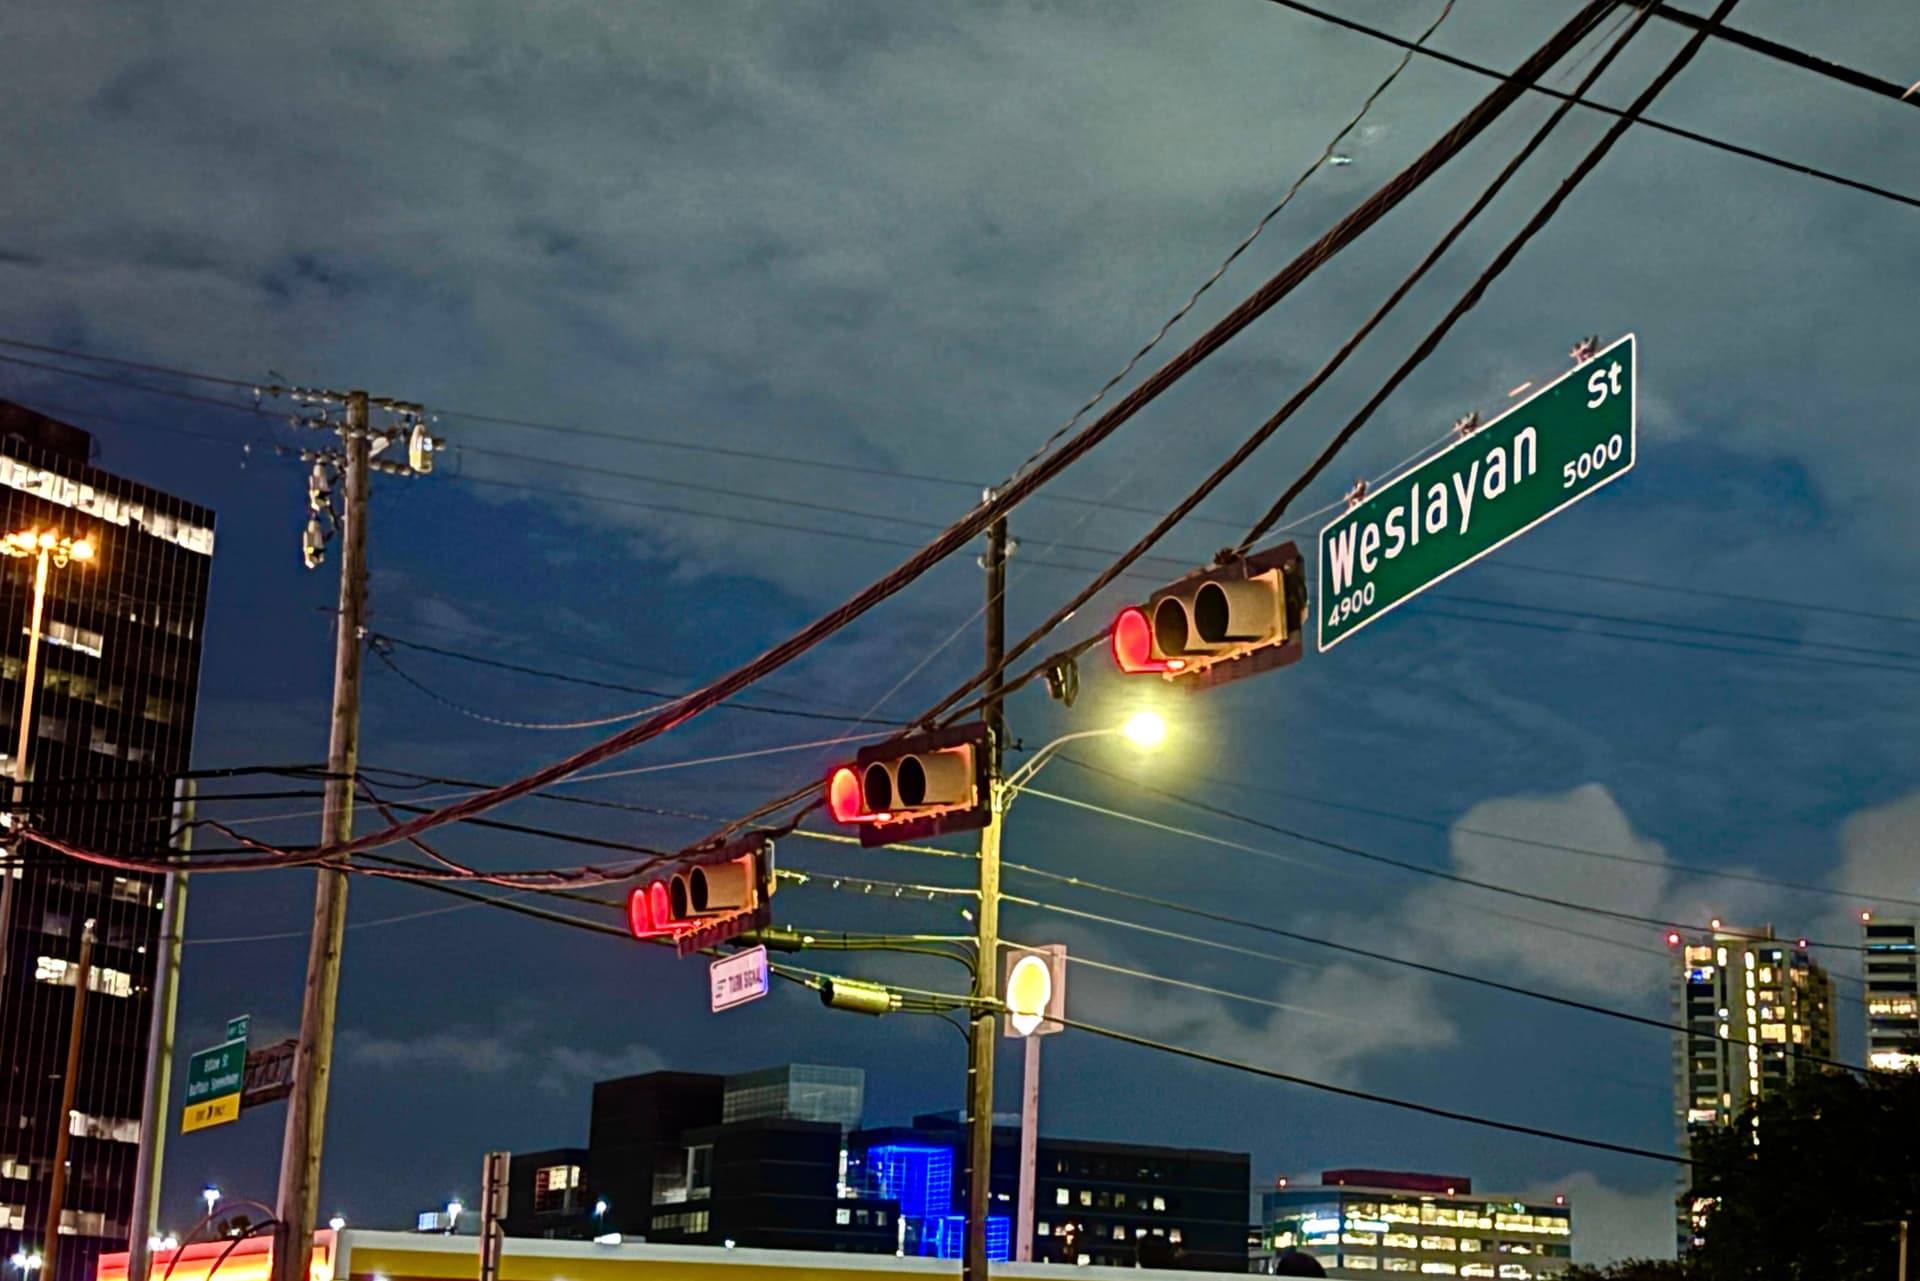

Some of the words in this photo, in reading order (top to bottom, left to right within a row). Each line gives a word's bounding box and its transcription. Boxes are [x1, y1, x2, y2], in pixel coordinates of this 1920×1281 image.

[1328, 426, 1537, 596] Weslayan
[1587, 360, 1622, 409] St
[1563, 434, 1623, 489] 5000
[1328, 581, 1375, 627] 4900
